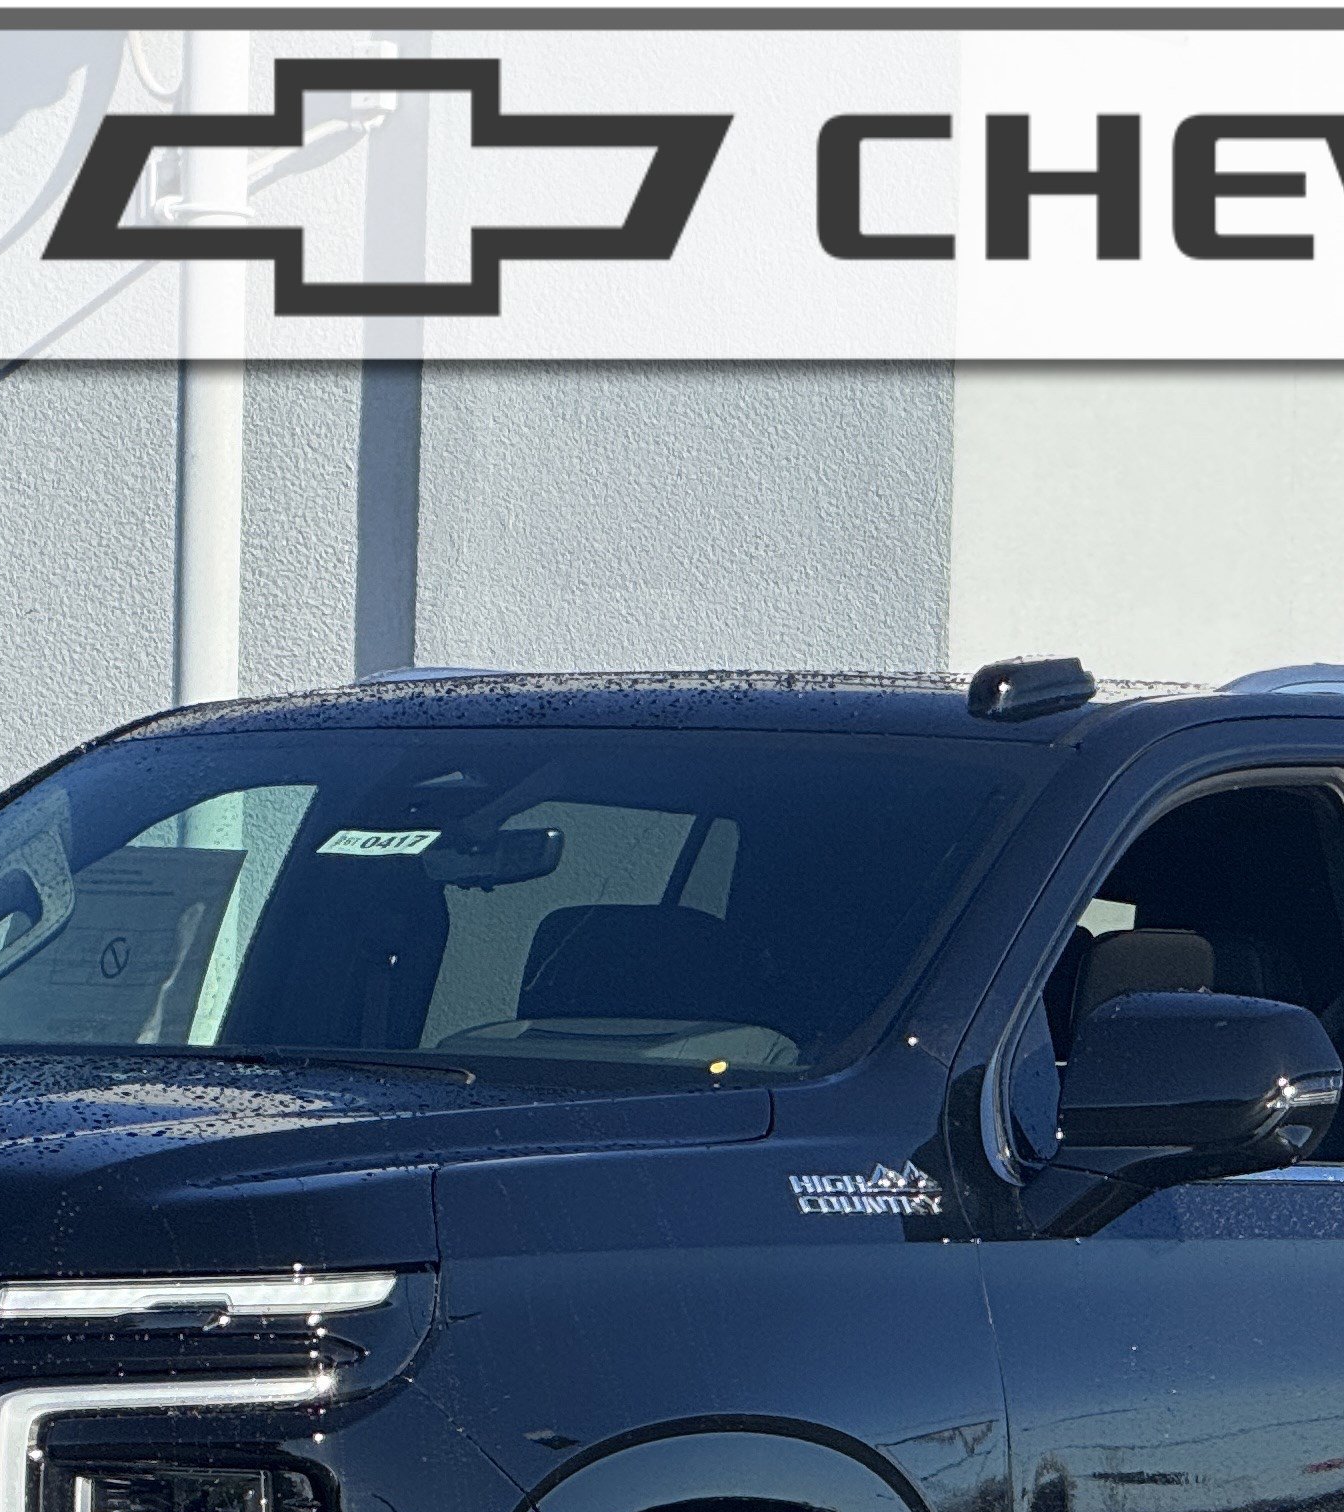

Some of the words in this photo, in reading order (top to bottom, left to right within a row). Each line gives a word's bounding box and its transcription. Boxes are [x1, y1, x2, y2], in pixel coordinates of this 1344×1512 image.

[360, 835, 430, 849] 0417
[788, 1174, 868, 1194] HIGH
[798, 1195, 944, 1216] COUNTRY
